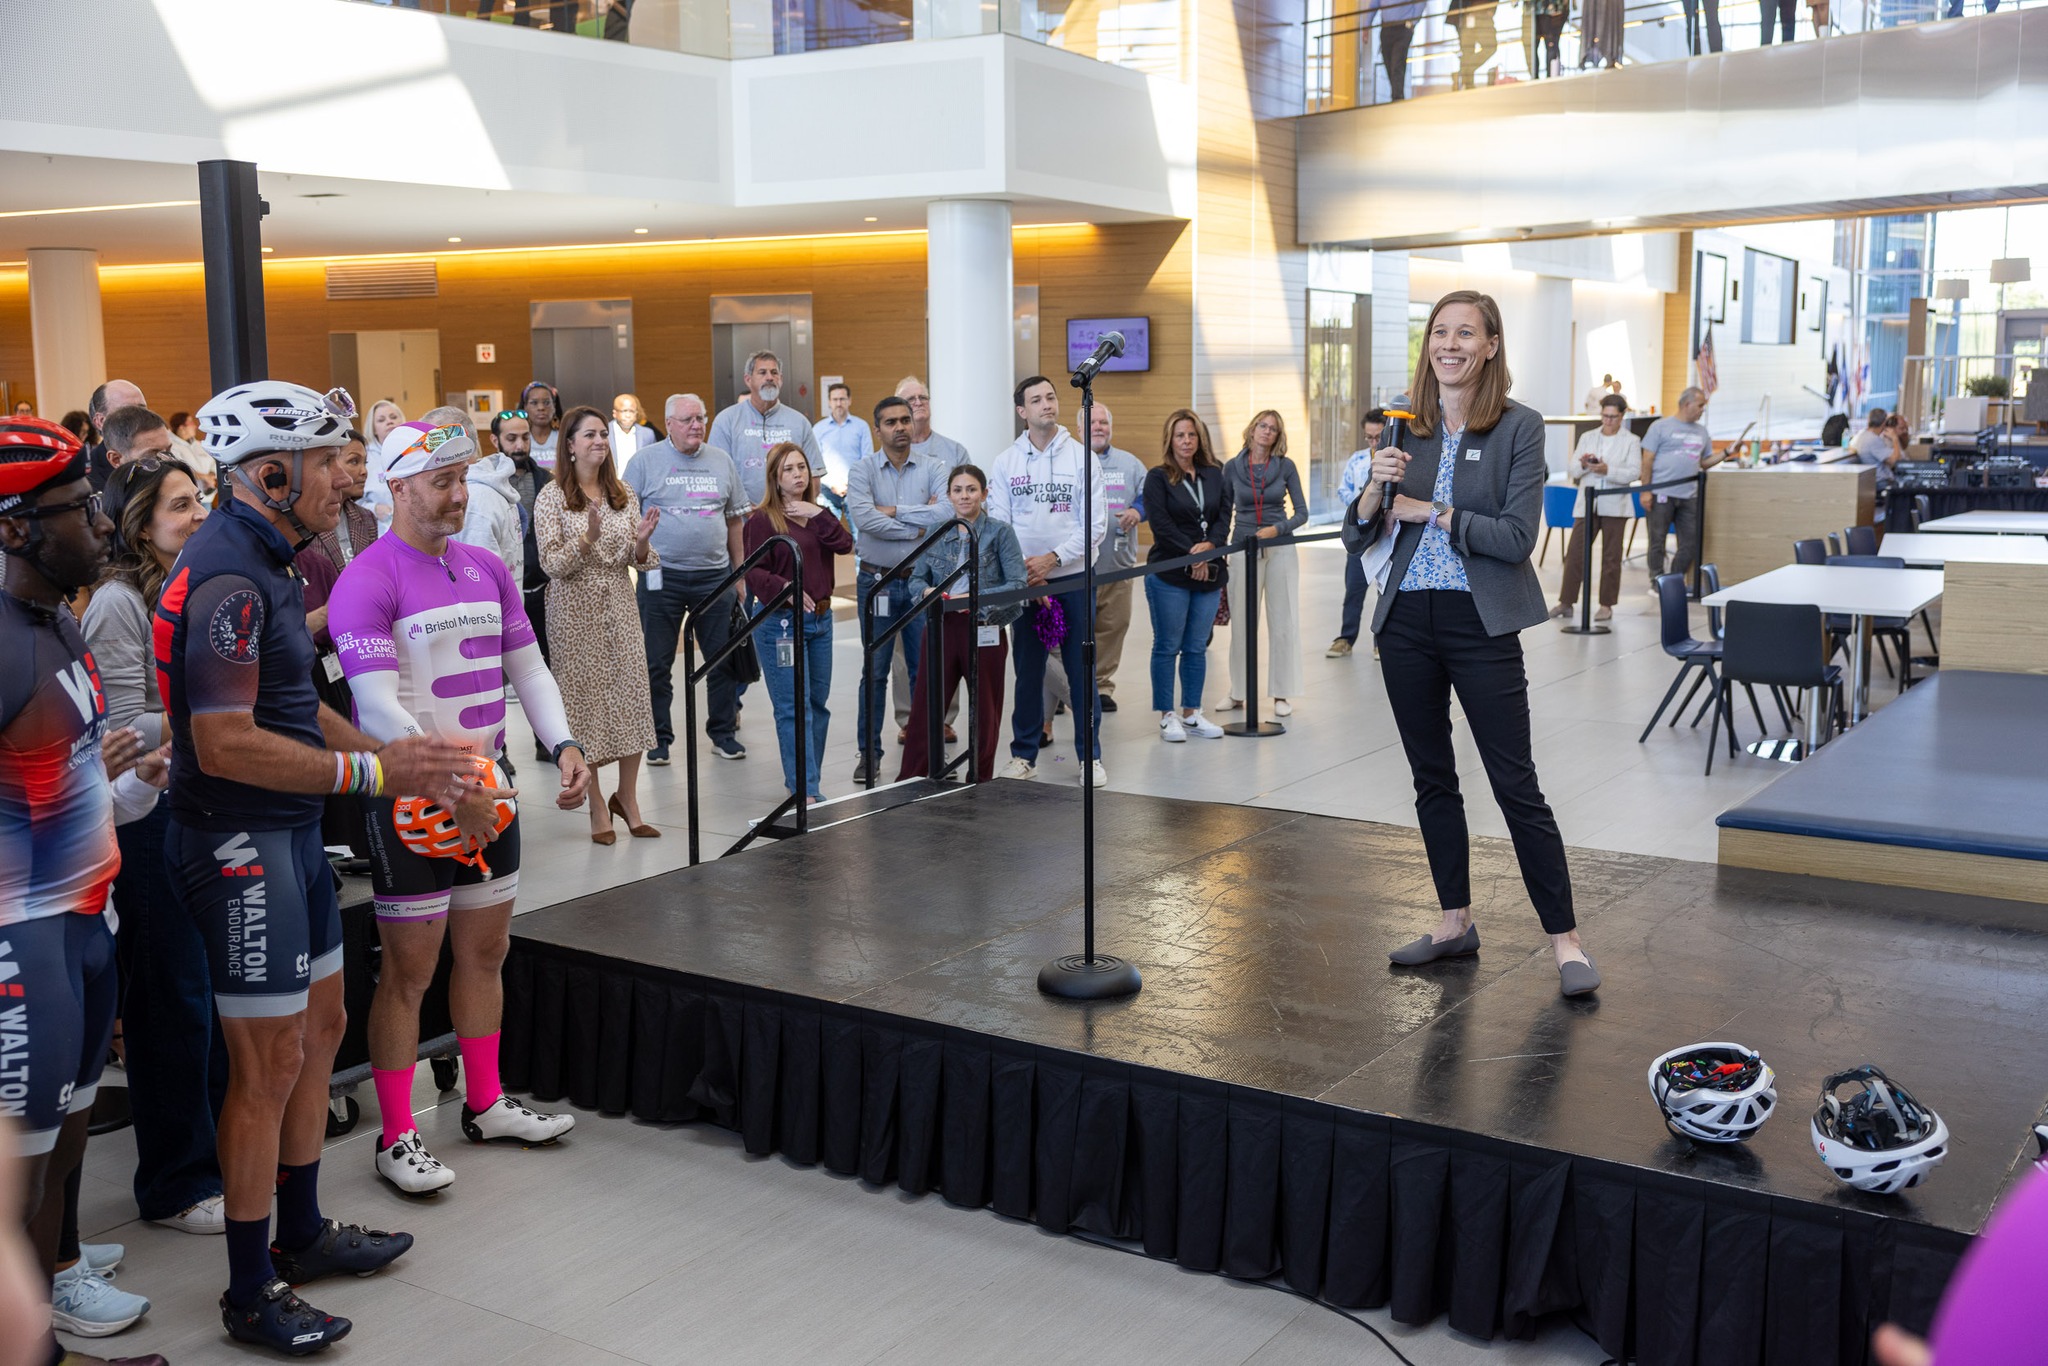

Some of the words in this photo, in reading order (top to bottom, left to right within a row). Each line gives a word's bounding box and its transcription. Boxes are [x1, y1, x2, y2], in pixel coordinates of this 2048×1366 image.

[269, 434, 312, 442] RUDY
[665, 477, 688, 485] COAST
[695, 477, 717, 485] COAST
[1010, 475, 1031, 487] 2022
[692, 484, 718, 492] CANCER
[1012, 484, 1038, 496] COAST
[1040, 483, 1043, 493] 2
[1045, 482, 1073, 493] COAST
[1034, 494, 1039, 503] 4
[1040, 493, 1072, 503] CANCER
[1052, 503, 1071, 512] RIDE
[425, 617, 457, 634] Bristol
[362, 638, 369, 647] 2
[357, 647, 365, 655] 4
[370, 811, 384, 850] Transforming
[227, 898, 242, 977] ENDURANCE
[243, 881, 267, 982] WALTON
[0, 1003, 30, 1117] WALTON
[291, 1331, 324, 1345] SIDI
